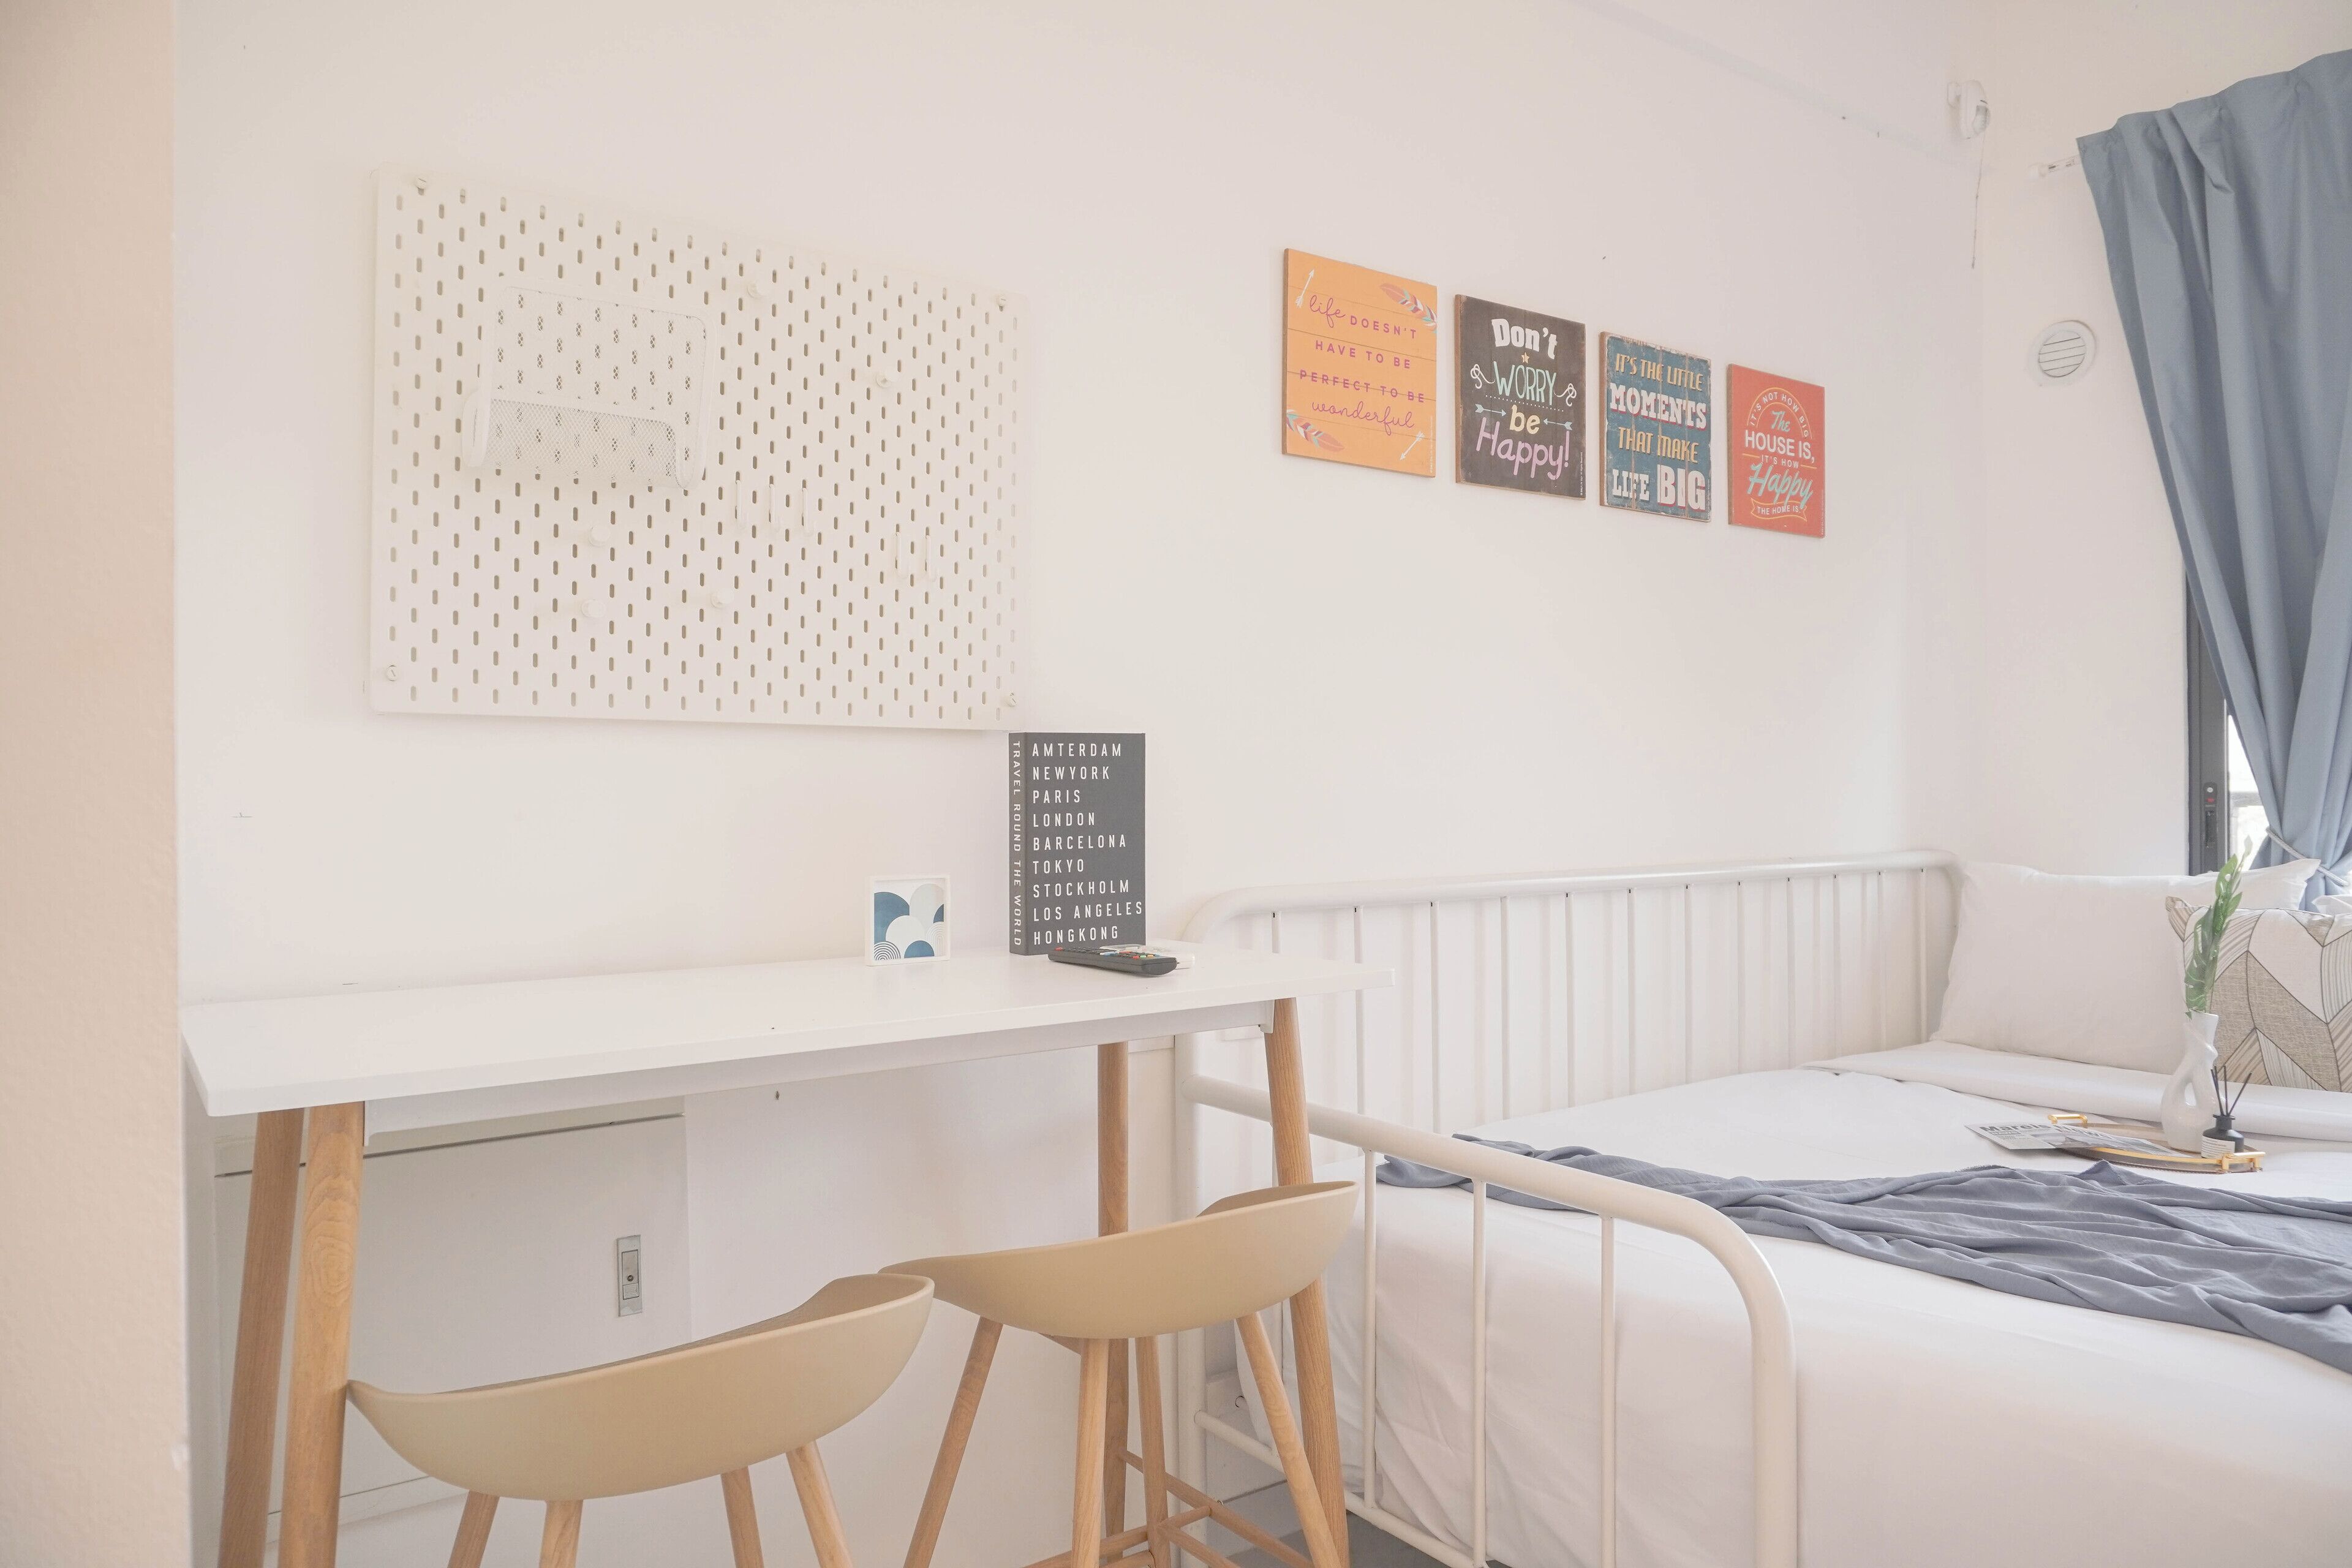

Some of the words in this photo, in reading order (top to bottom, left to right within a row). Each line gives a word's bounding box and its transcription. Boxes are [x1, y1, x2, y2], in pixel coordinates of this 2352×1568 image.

[1310, 295, 1346, 328] life
[1350, 315, 1416, 338] DOESN'T
[1491, 318, 1558, 360] Don't
[1316, 341, 1355, 358] HAVE
[1366, 351, 1383, 363] TO
[1394, 357, 1410, 369] BE
[1300, 370, 1370, 392] PERFECT
[1380, 386, 1398, 398] TO
[1408, 391, 1424, 402] BE
[1493, 361, 1556, 405] WORRY
[1616, 353, 1637, 375] IT'S
[1641, 359, 1664, 382] THE
[1667, 366, 1703, 391] LITTLE
[1312, 401, 1415, 435] wonderful
[1510, 405, 1540, 434] be
[1610, 383, 1706, 431] MOMENTS
[1751, 404, 1762, 426] IT'S
[1763, 392, 1777, 404] NOT
[1782, 394, 1798, 412] HOW
[1800, 416, 1809, 437] BIG
[1772, 410, 1790, 432] The
[1476, 417, 1570, 480] Happy!
[1619, 427, 1653, 454] THAT
[1657, 435, 1698, 463] MAKE
[1746, 429, 1795, 456] HOUSE
[1799, 440, 1814, 464] IS,
[1762, 455, 1777, 465] IT'S
[1782, 459, 1798, 468] HOW
[1612, 469, 1649, 501] LIFE
[1657, 464, 1706, 511] BIG
[1747, 462, 1813, 510] Happy
[1757, 507, 1770, 515] THE
[1032, 744, 1121, 756] AMTERDAM
[1033, 766, 1109, 780] NEWYORK
[1033, 790, 1080, 804] PARIS
[1034, 812, 1095, 827] LONDON
[1034, 834, 1126, 851] BARCELONA
[1033, 859, 1084, 874] TOKYO
[1034, 880, 1128, 898] STOCKHOLM
[1034, 907, 1061, 921] LOS
[1074, 902, 1142, 919] ANGELES
[1034, 926, 1118, 945] HONGKONG
